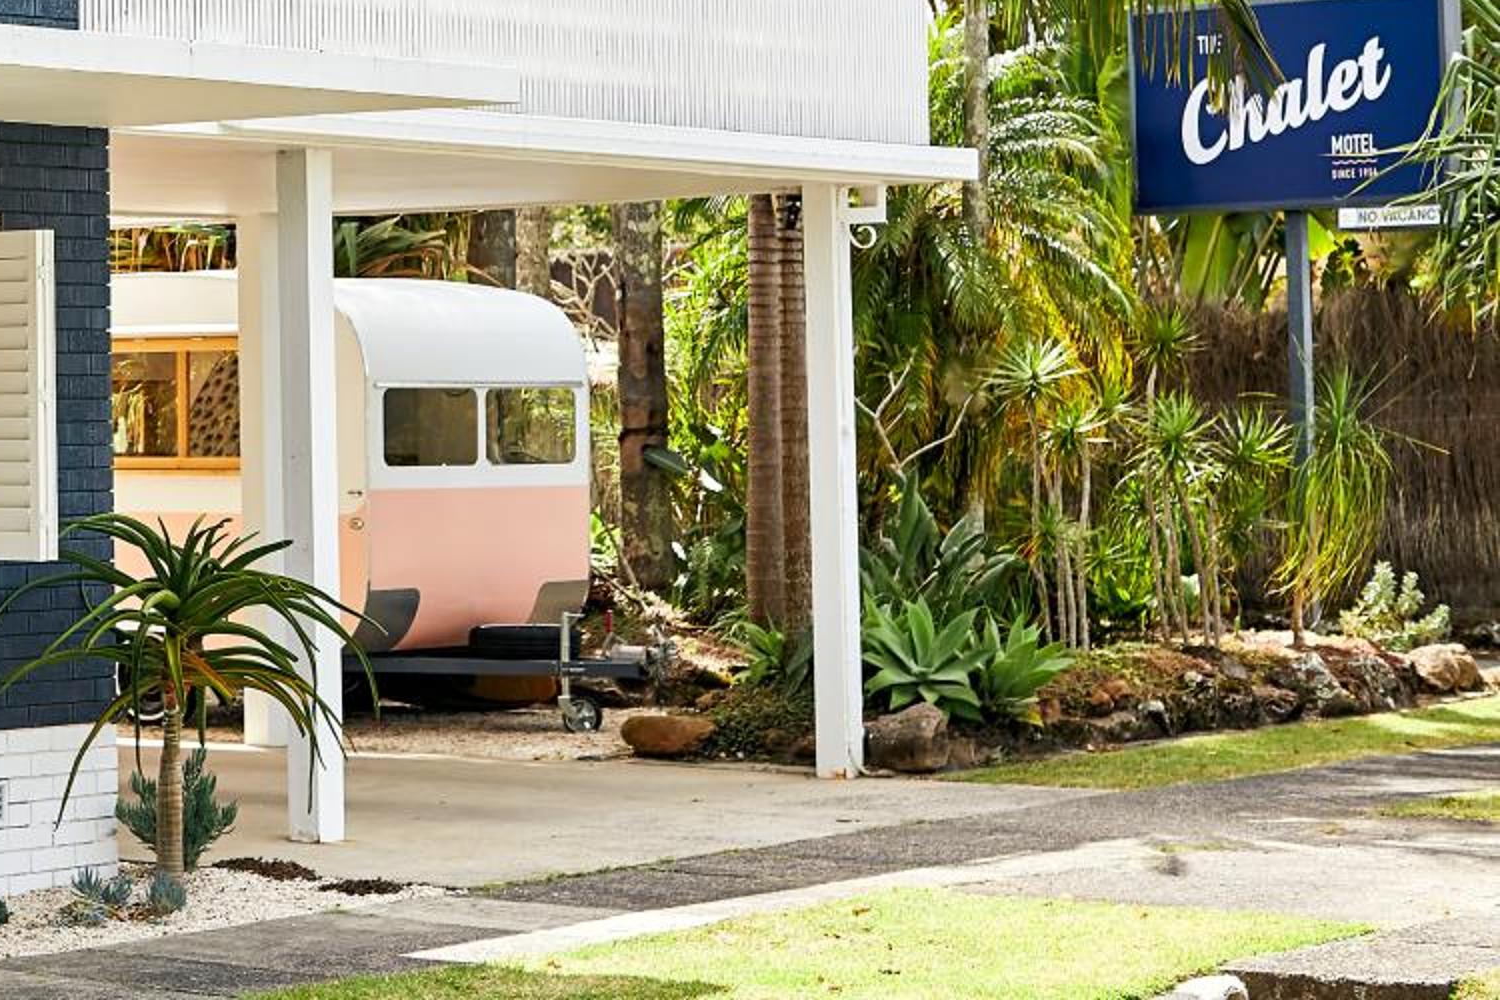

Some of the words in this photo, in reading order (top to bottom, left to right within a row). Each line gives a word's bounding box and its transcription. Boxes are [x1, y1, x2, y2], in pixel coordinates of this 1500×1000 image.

[1182, 36, 1392, 166] Chalet
[1331, 133, 1378, 155] MOTEL
[1358, 210, 1377, 223] NO
